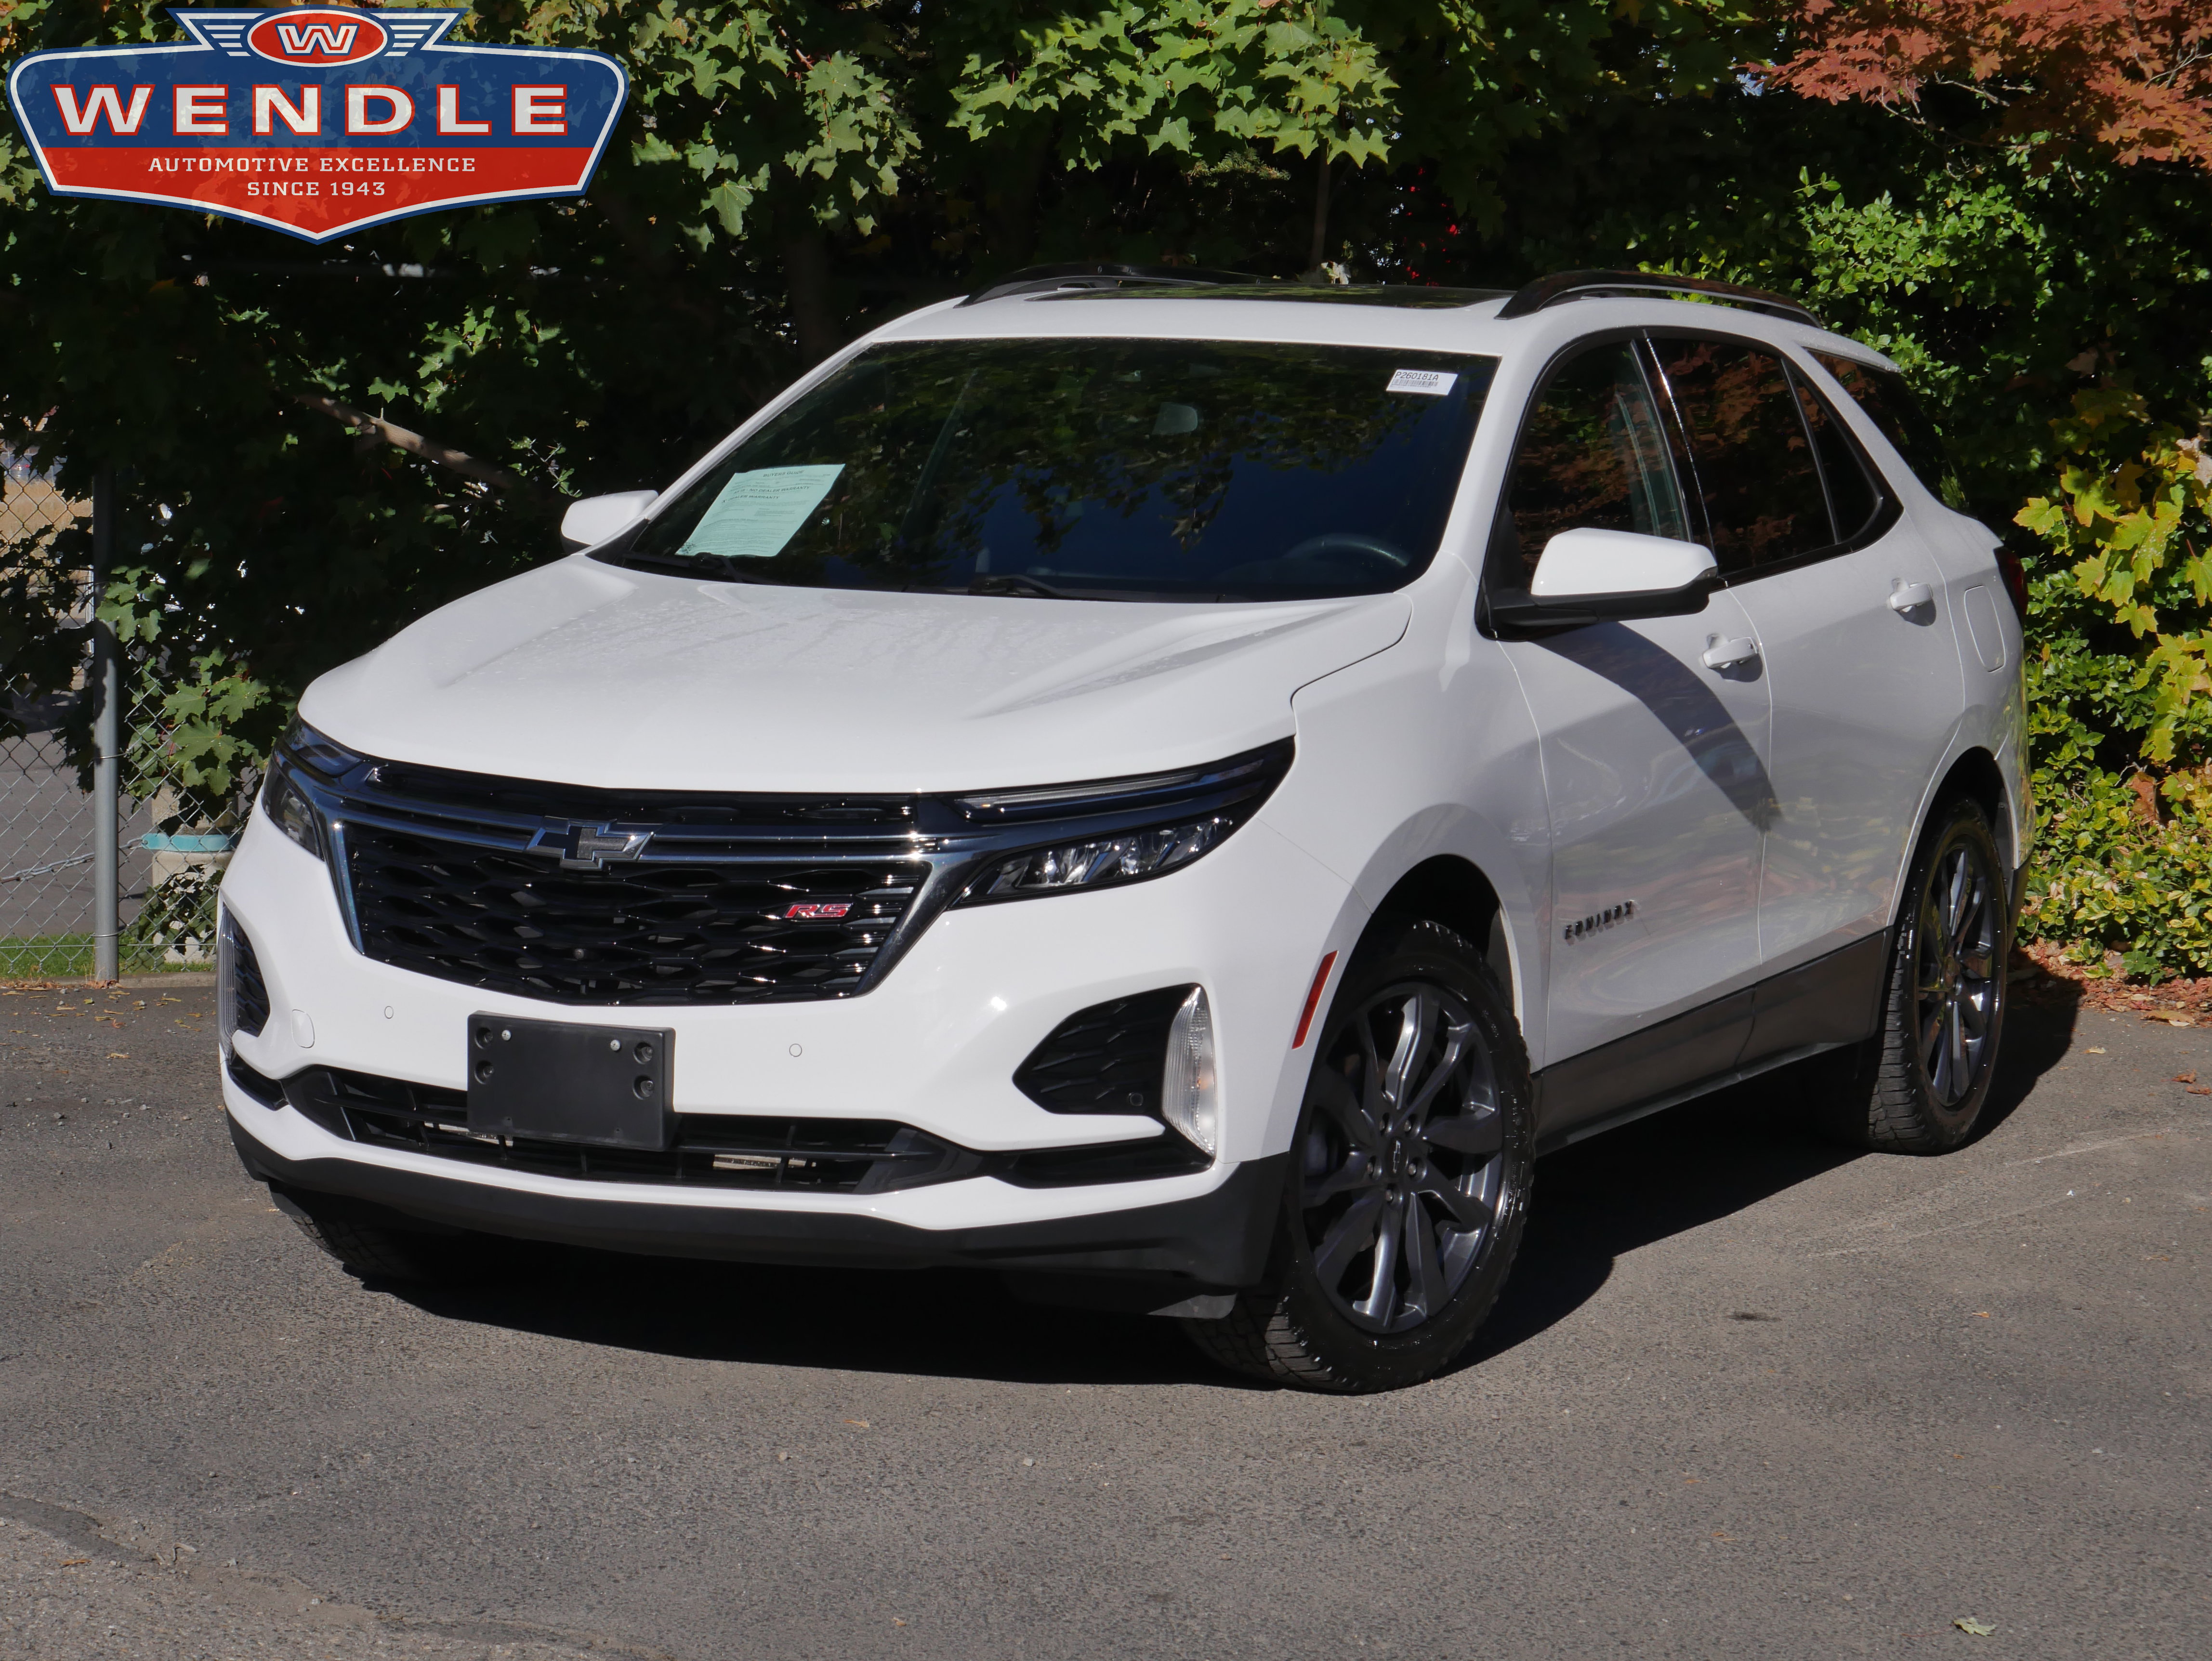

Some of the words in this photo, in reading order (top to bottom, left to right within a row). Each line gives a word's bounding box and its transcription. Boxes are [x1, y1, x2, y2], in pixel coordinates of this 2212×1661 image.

[1395, 371, 1439, 381] P260181A
[784, 903, 852, 918] RS
[1565, 900, 1633, 940] EQUINOX
